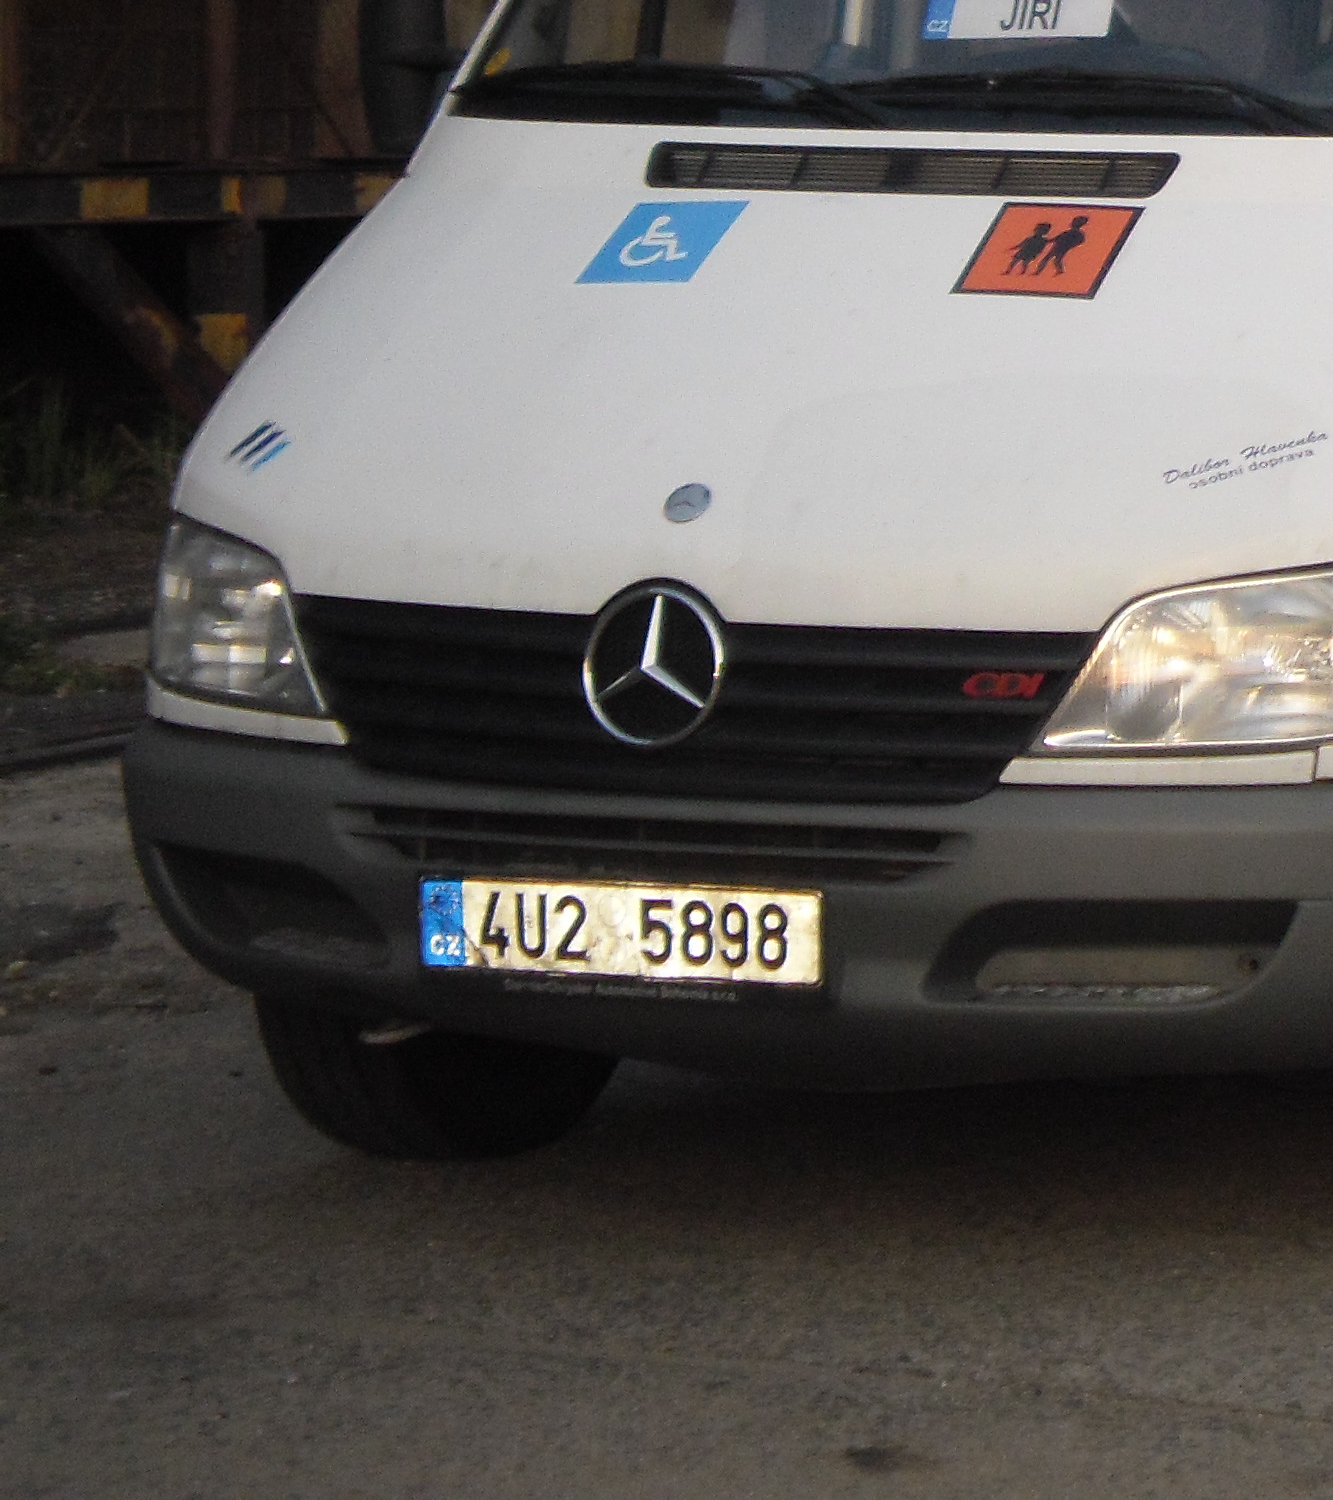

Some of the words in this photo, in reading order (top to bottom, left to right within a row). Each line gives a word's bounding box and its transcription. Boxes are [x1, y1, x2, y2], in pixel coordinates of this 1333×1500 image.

[1163, 458, 1230, 484] Dalibor
[1189, 464, 1244, 490] osobní
[1249, 449, 1314, 472] doprava
[962, 671, 1046, 699] CDI
[430, 933, 460, 957] CZ
[479, 892, 590, 962] 4U2
[640, 899, 788, 970] 5898
